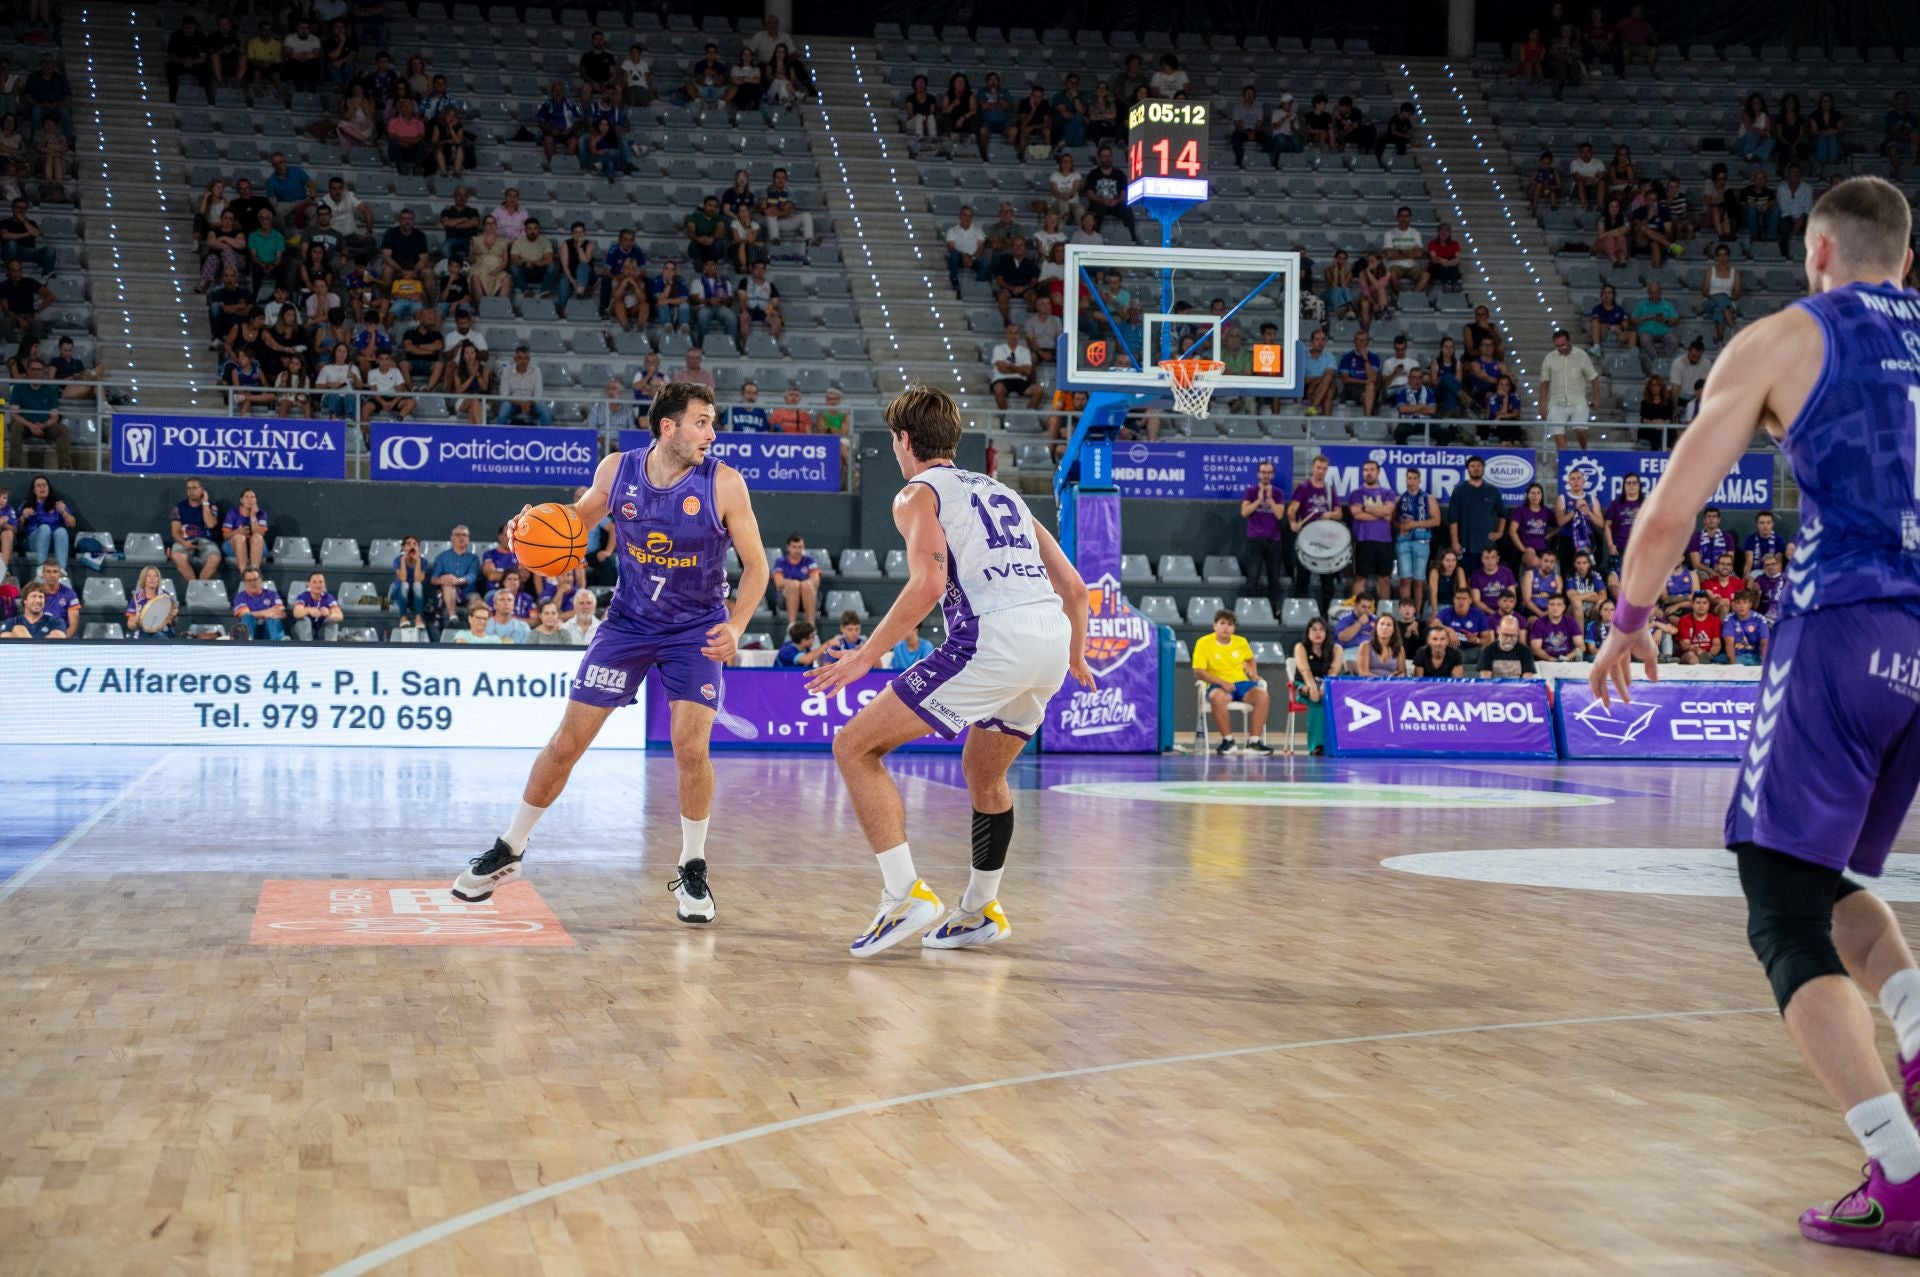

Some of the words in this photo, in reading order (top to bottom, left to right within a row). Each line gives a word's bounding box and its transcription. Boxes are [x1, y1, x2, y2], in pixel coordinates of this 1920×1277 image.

[1148, 103, 1205, 124] 05:12
[1130, 140, 1143, 180] 14
[1152, 139, 1200, 176] 14
[163, 424, 336, 450] POLICLÍNICA
[196, 449, 304, 470] DENTAL
[440, 438, 592, 463] patriciaOrdás
[761, 444, 827, 459] varas
[1203, 455, 1280, 464] RESTAURANTE
[768, 461, 826, 480] dental
[1146, 468, 1185, 481] DANI
[1203, 464, 1248, 472] COMIDAS
[1203, 473, 1236, 481] TAPAS
[1490, 467, 1524, 475] MAURI
[970, 492, 1031, 549] 12
[629, 546, 697, 569] agropal
[650, 575, 667, 602] 7
[55, 667, 92, 693] C/
[100, 667, 251, 694] Alfareros
[263, 670, 300, 694] 44
[335, 671, 359, 695] P.
[401, 671, 461, 697] San
[584, 665, 627, 689] gaza
[907, 671, 927, 691] CBC
[1071, 687, 1123, 709] JUEGA
[194, 703, 249, 728] Tel.
[262, 704, 318, 729] 979
[330, 706, 385, 729] 720
[397, 706, 451, 730] 659
[1061, 703, 1136, 729] PALENCIA
[1401, 702, 1544, 724] ARAMBOL
[768, 721, 808, 735] IoT
[1400, 723, 1467, 732] INGENIERIA
